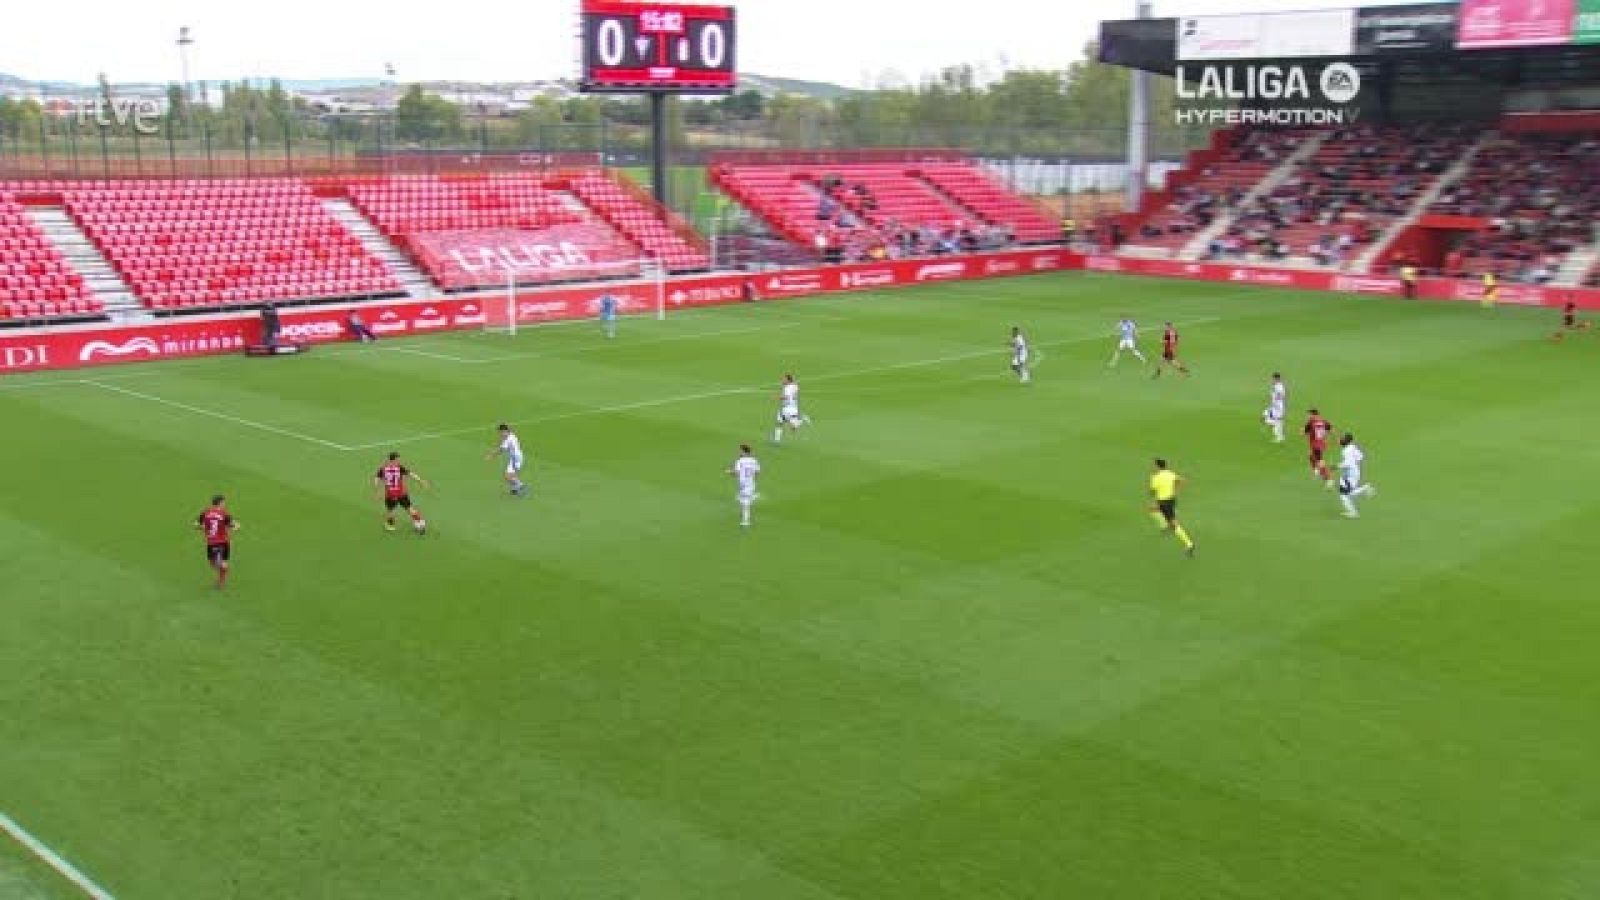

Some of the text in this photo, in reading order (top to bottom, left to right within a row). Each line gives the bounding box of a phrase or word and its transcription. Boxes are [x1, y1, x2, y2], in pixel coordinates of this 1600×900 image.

[599, 20, 624, 66] 0
[702, 23, 724, 67] 0
[0, 344, 49, 367] DI
